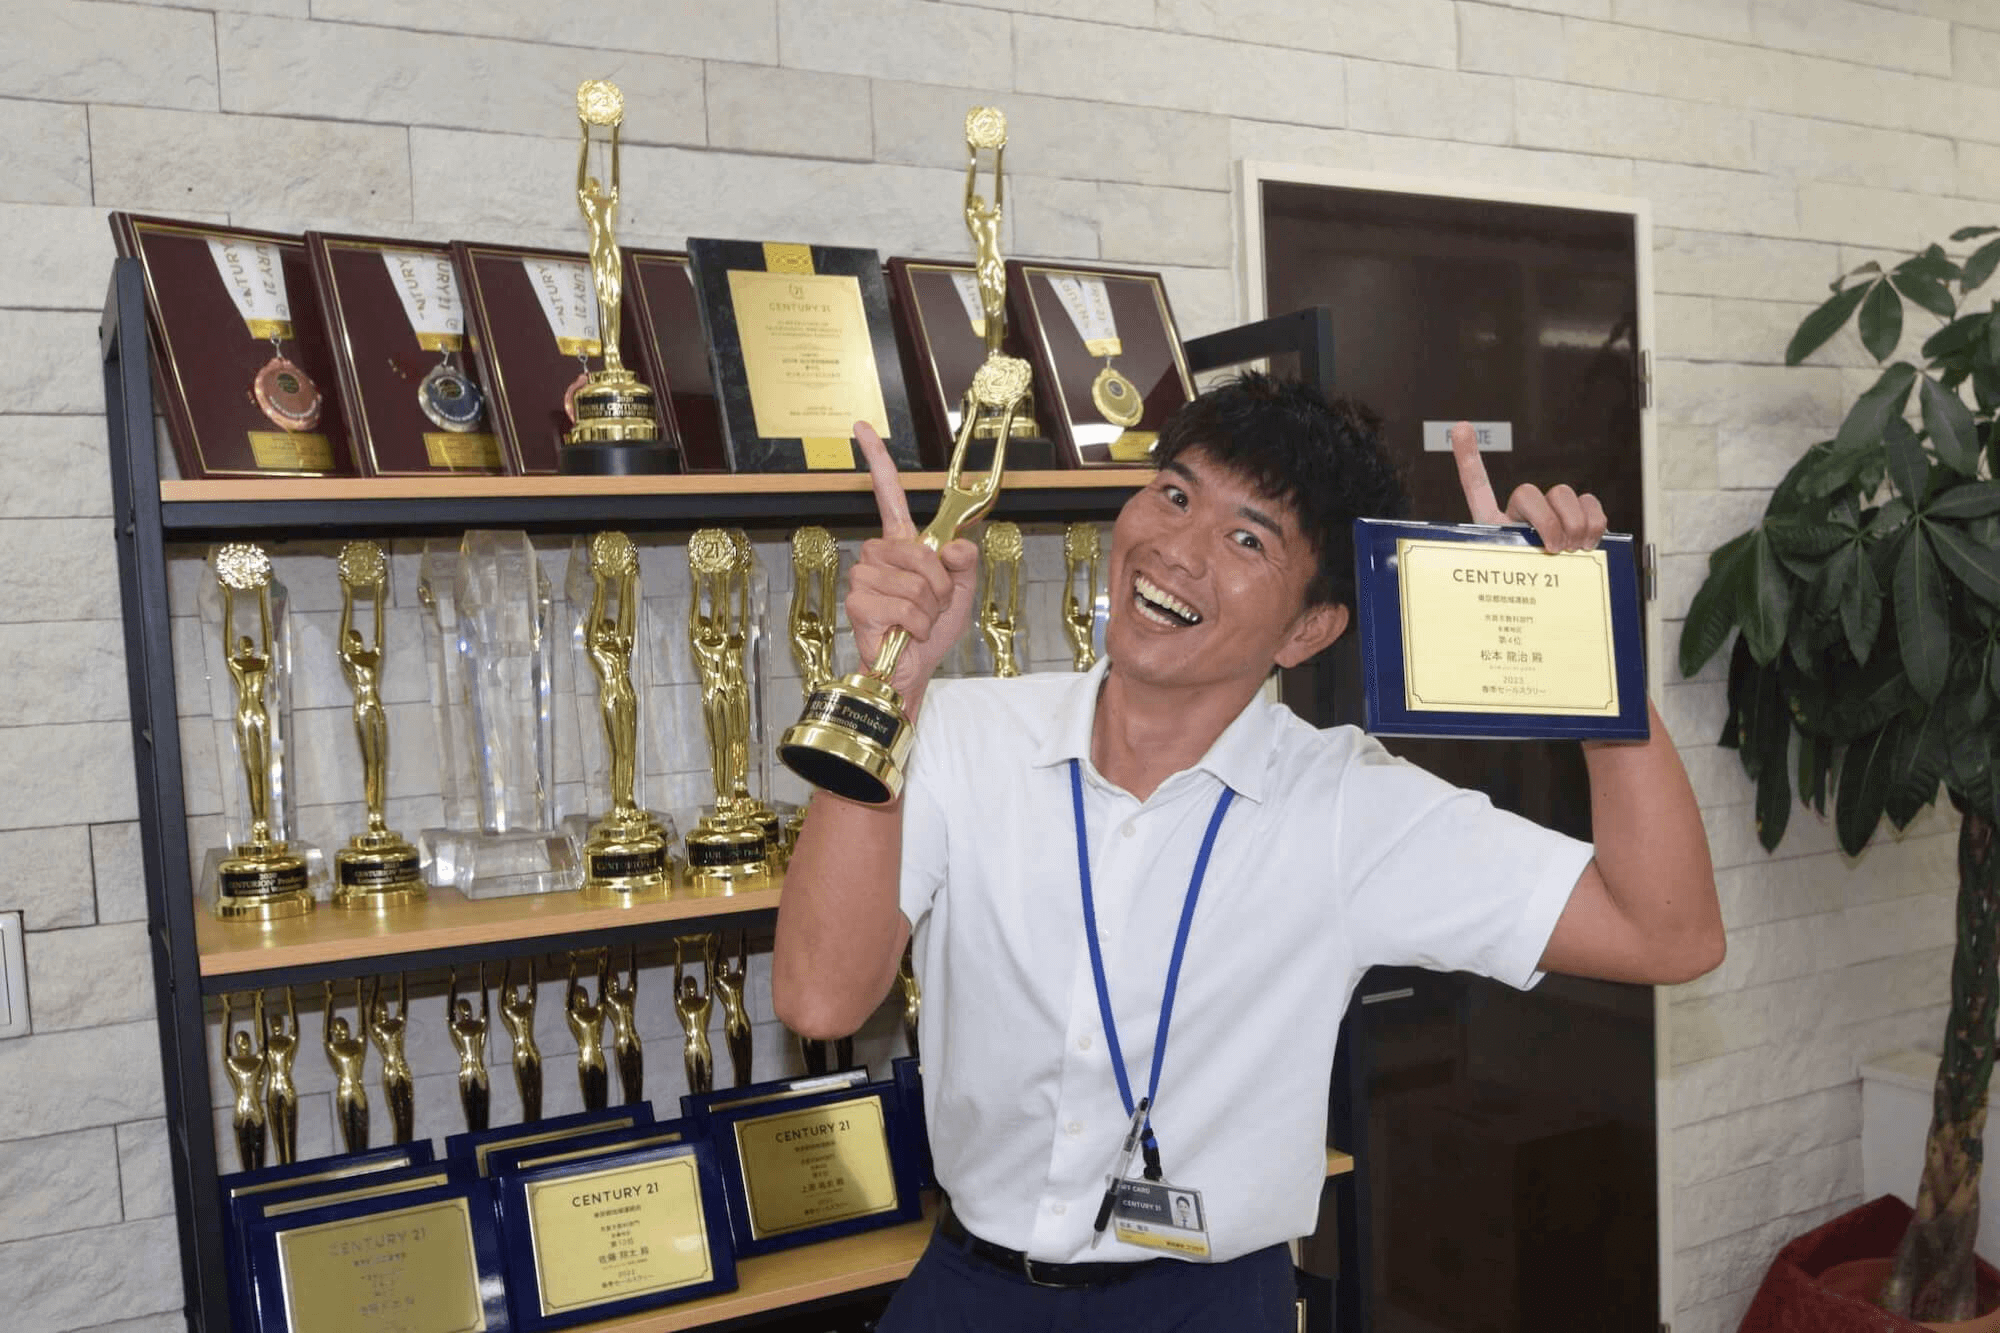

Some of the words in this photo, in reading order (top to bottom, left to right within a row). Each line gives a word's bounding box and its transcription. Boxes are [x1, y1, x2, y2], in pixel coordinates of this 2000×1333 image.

[703, 542, 719, 559] 21
[1452, 568, 1539, 587] CENTURY
[1544, 573, 1560, 588] 21
[1481, 649, 1503, 661] 松本
[774, 1123, 835, 1144] CENTURY
[839, 1120, 850, 1132] 21
[572, 1184, 642, 1208] CENTURY
[646, 1182, 660, 1194] 21
[328, 1231, 407, 1257] CENTURY
[412, 1227, 426, 1241] 21
